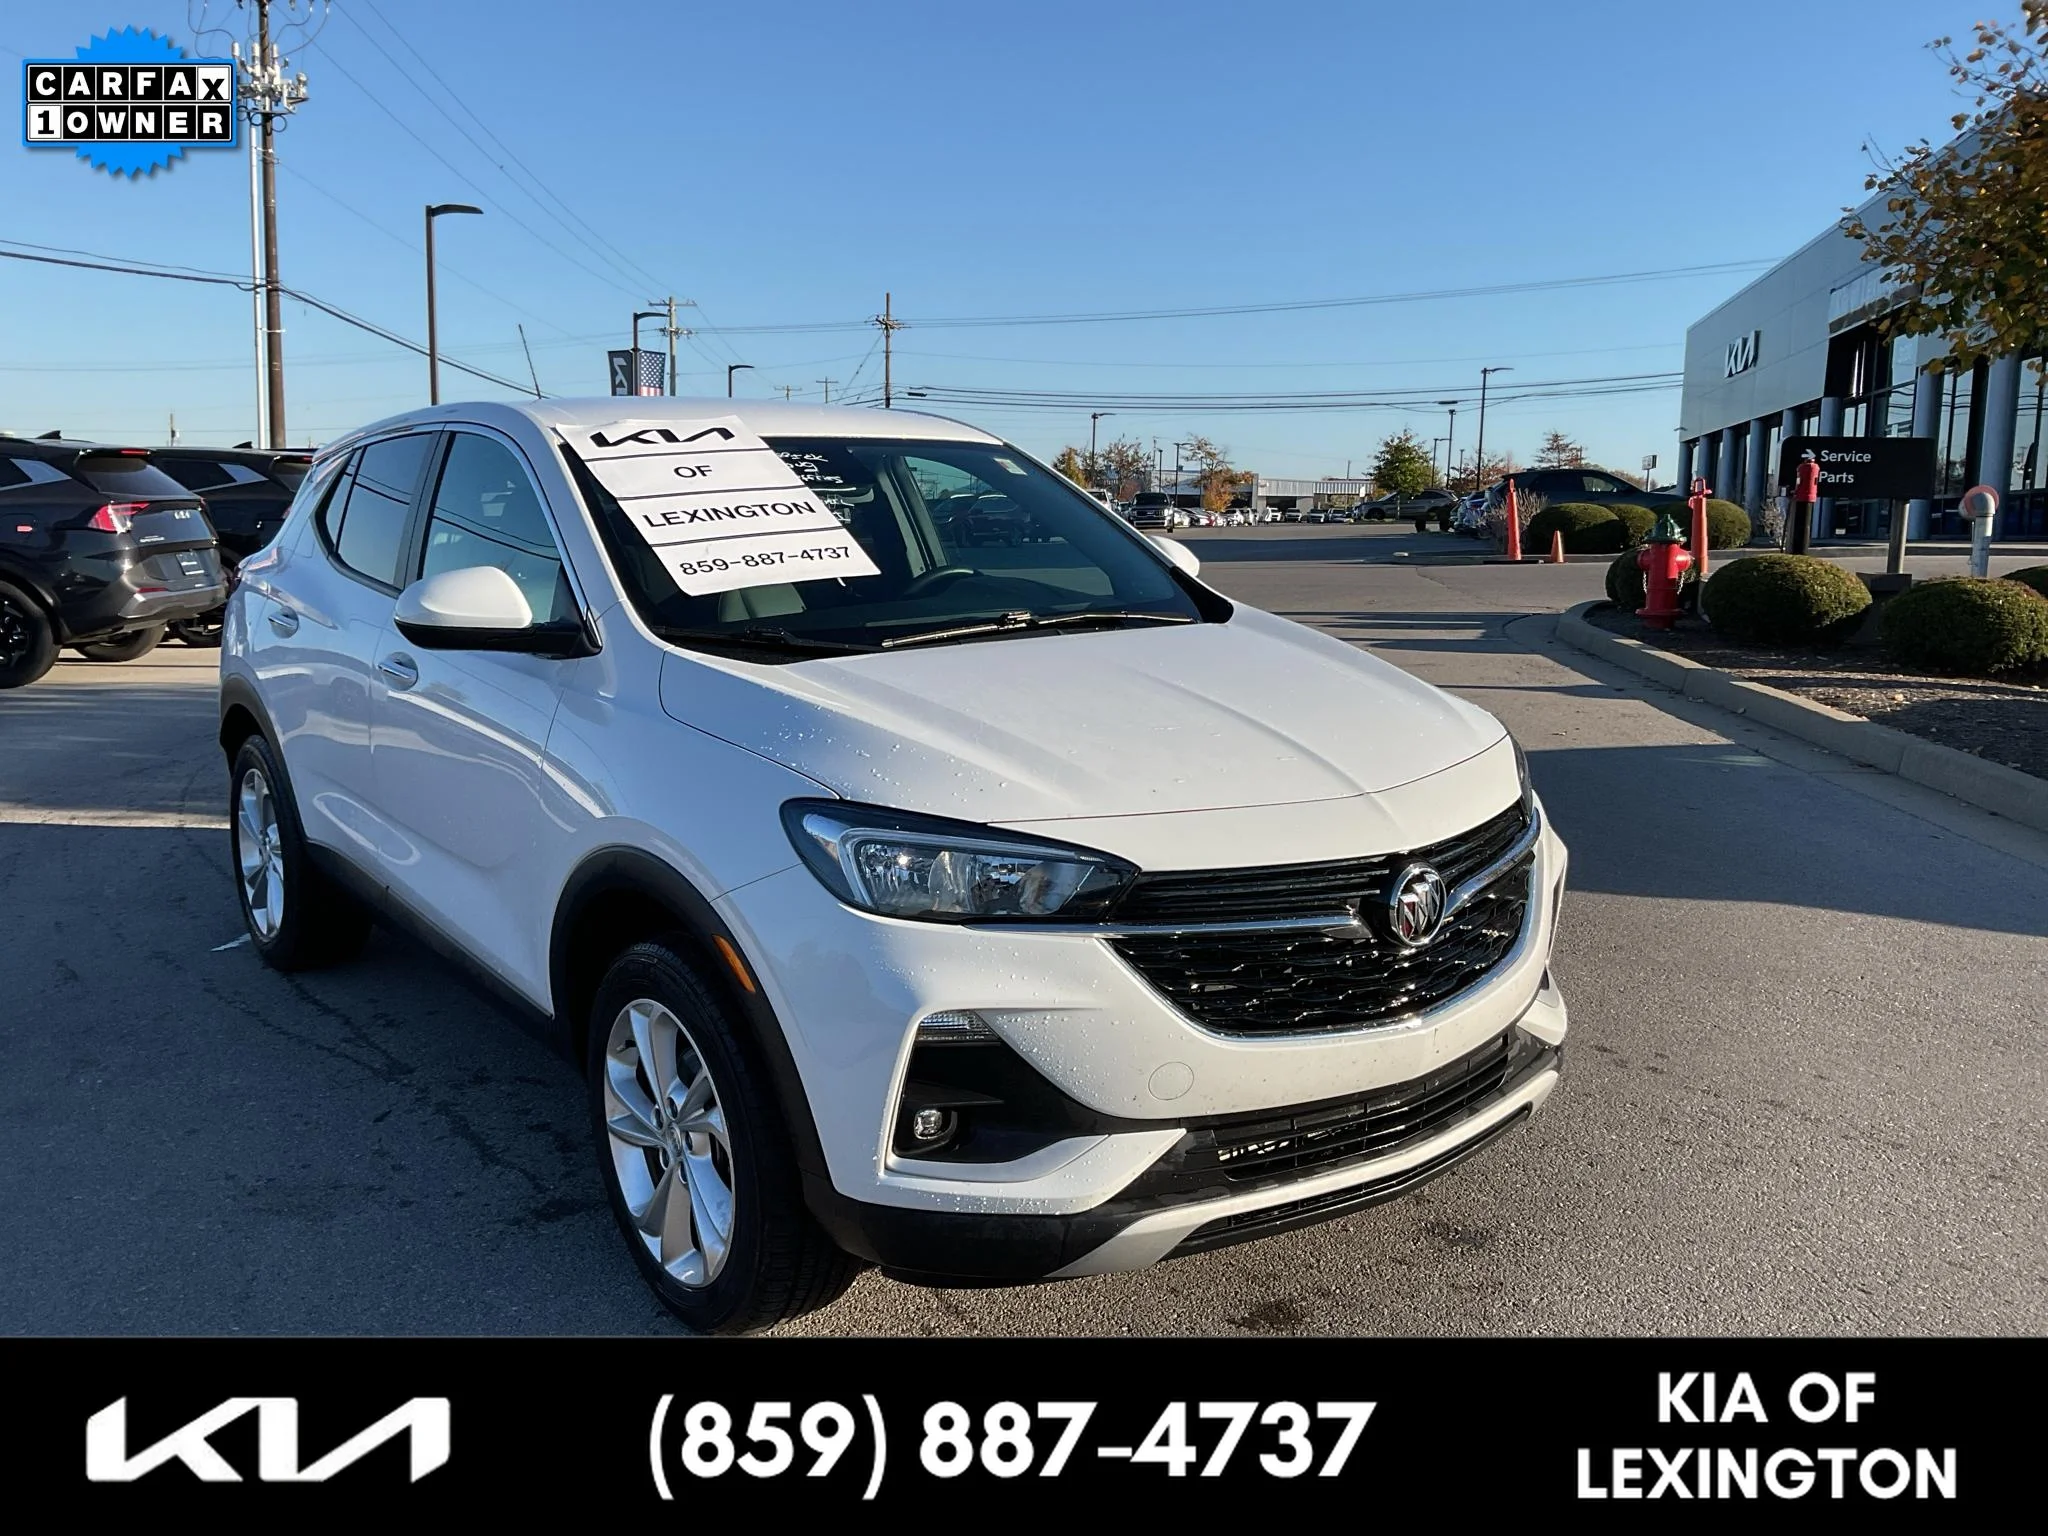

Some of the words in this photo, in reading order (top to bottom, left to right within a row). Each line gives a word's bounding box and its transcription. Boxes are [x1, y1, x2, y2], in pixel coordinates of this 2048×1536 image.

[1723, 330, 1761, 379] KIA
[589, 427, 736, 448] KIA
[1820, 450, 1872, 463] Service
[673, 464, 713, 479] OF
[1819, 471, 1855, 483] Parts
[642, 501, 816, 528] LEXINGTON
[679, 546, 851, 576] 859-887-4737
